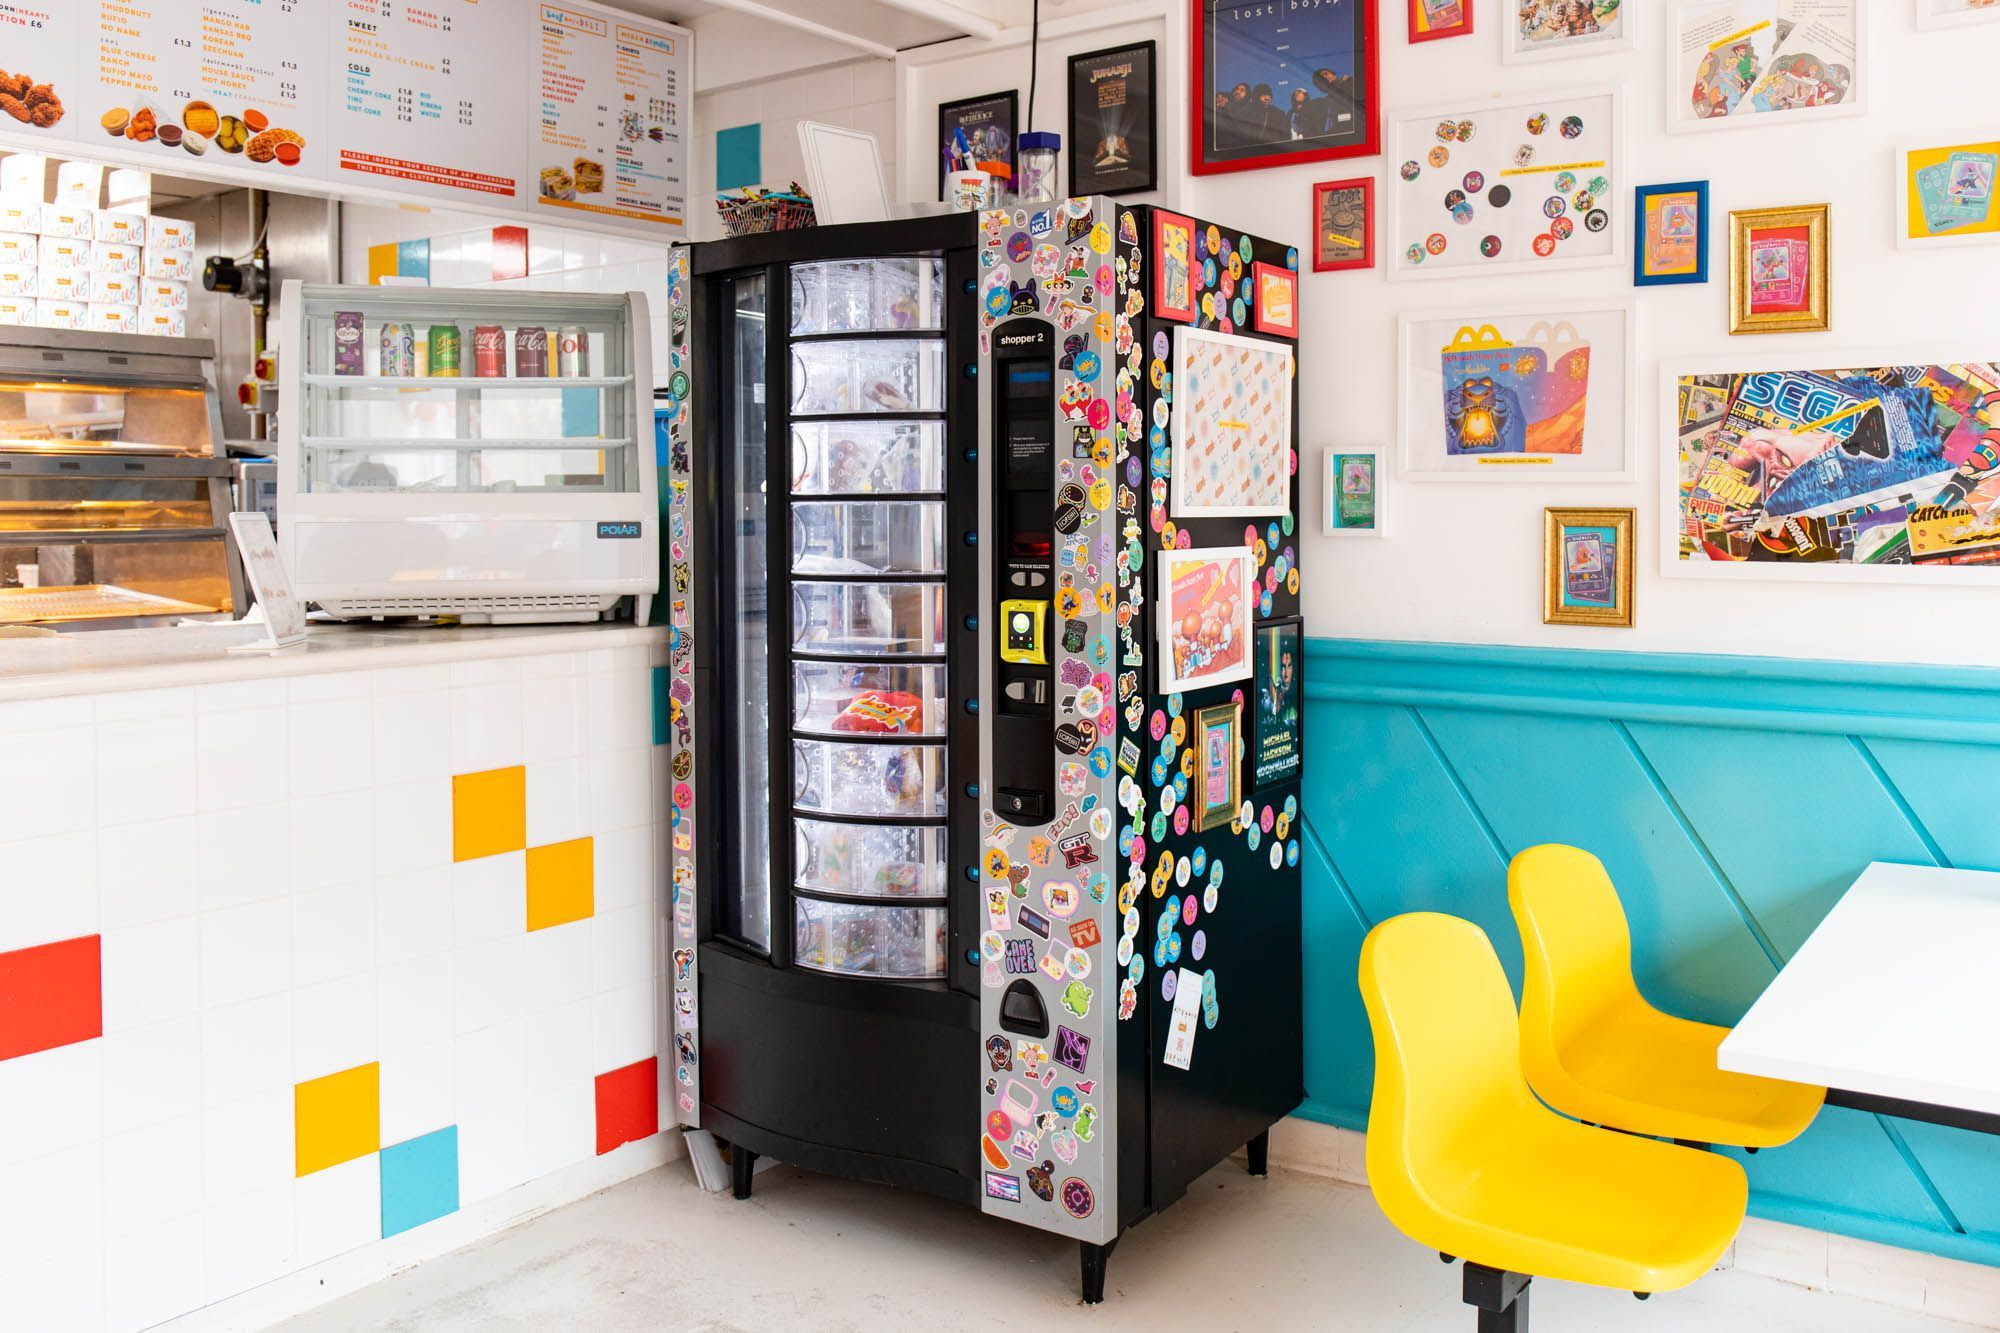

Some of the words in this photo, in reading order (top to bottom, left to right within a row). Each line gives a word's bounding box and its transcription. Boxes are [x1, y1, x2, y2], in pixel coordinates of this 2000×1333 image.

[282, 4, 292, 12] £2
[348, 2, 376, 14] CHOCO
[382, 10, 391, 18] £4
[407, 8, 438, 20] BANANA
[1234, 6, 1273, 20] lost
[31, 20, 42, 28] £6
[101, 23, 113, 32] NO
[117, 27, 141, 37] NAME
[202, 16, 232, 27] MANGO
[234, 22, 251, 31] HAB
[348, 20, 377, 32] SWEET
[407, 18, 438, 30] VANILLA
[543, 26, 564, 35] SAUCES
[202, 25, 234, 37] KANSAS
[236, 32, 252, 41] BBQ
[202, 35, 235, 47] KOREAN
[348, 36, 372, 47] APPLE
[376, 42, 388, 51] PIE
[101, 46, 122, 55] BLUE
[124, 49, 157, 62] CHEESE
[202, 45, 245, 58] SZECHUAN
[100, 56, 130, 66] RANCH
[348, 47, 383, 60] WAFFLES
[396, 56, 407, 65] ICE
[410, 59, 436, 71] CREAM
[442, 58, 450, 66] £2
[129, 70, 153, 81] MAYO
[202, 66, 228, 77] HOUSE
[231, 72, 256, 82] SAUCE
[348, 64, 371, 74] COLD
[100, 76, 132, 88] PEPPER
[135, 82, 158, 92] MAYO
[202, 76, 217, 84] HOT
[220, 80, 247, 90] HONEY
[348, 86, 372, 97] CHERRY
[374, 91, 392, 100] COKE
[543, 118, 556, 126] COLD
[344, 152, 370, 162] PLEASE
[372, 156, 400, 166] INFORM
[402, 162, 420, 170] YOUR
[423, 164, 447, 174] SERVER
[476, 173, 512, 185] ALLERGENS
[357, 164, 372, 172] THIS
[386, 168, 400, 176] NOT
[409, 172, 436, 182] GLUTEN
[437, 176, 454, 185] FREE
[456, 179, 502, 193] ENVIRONMENT
[616, 196, 638, 205] VENDING
[639, 200, 662, 208] MACHINE
[1000, 334, 1036, 345] shopper
[1037, 332, 1044, 342] 2
[1690, 498, 1725, 516] EXTRA!
[1910, 506, 1948, 523] CATCH
[600, 525, 638, 535] POLAR
[1264, 732, 1291, 746] MICHAEL
[1264, 744, 1292, 761] JACKSON
[1063, 846, 1098, 868] R
[1072, 926, 1096, 947] TV
[1005, 939, 1034, 958] GAME
[1007, 954, 1037, 973] OVER
